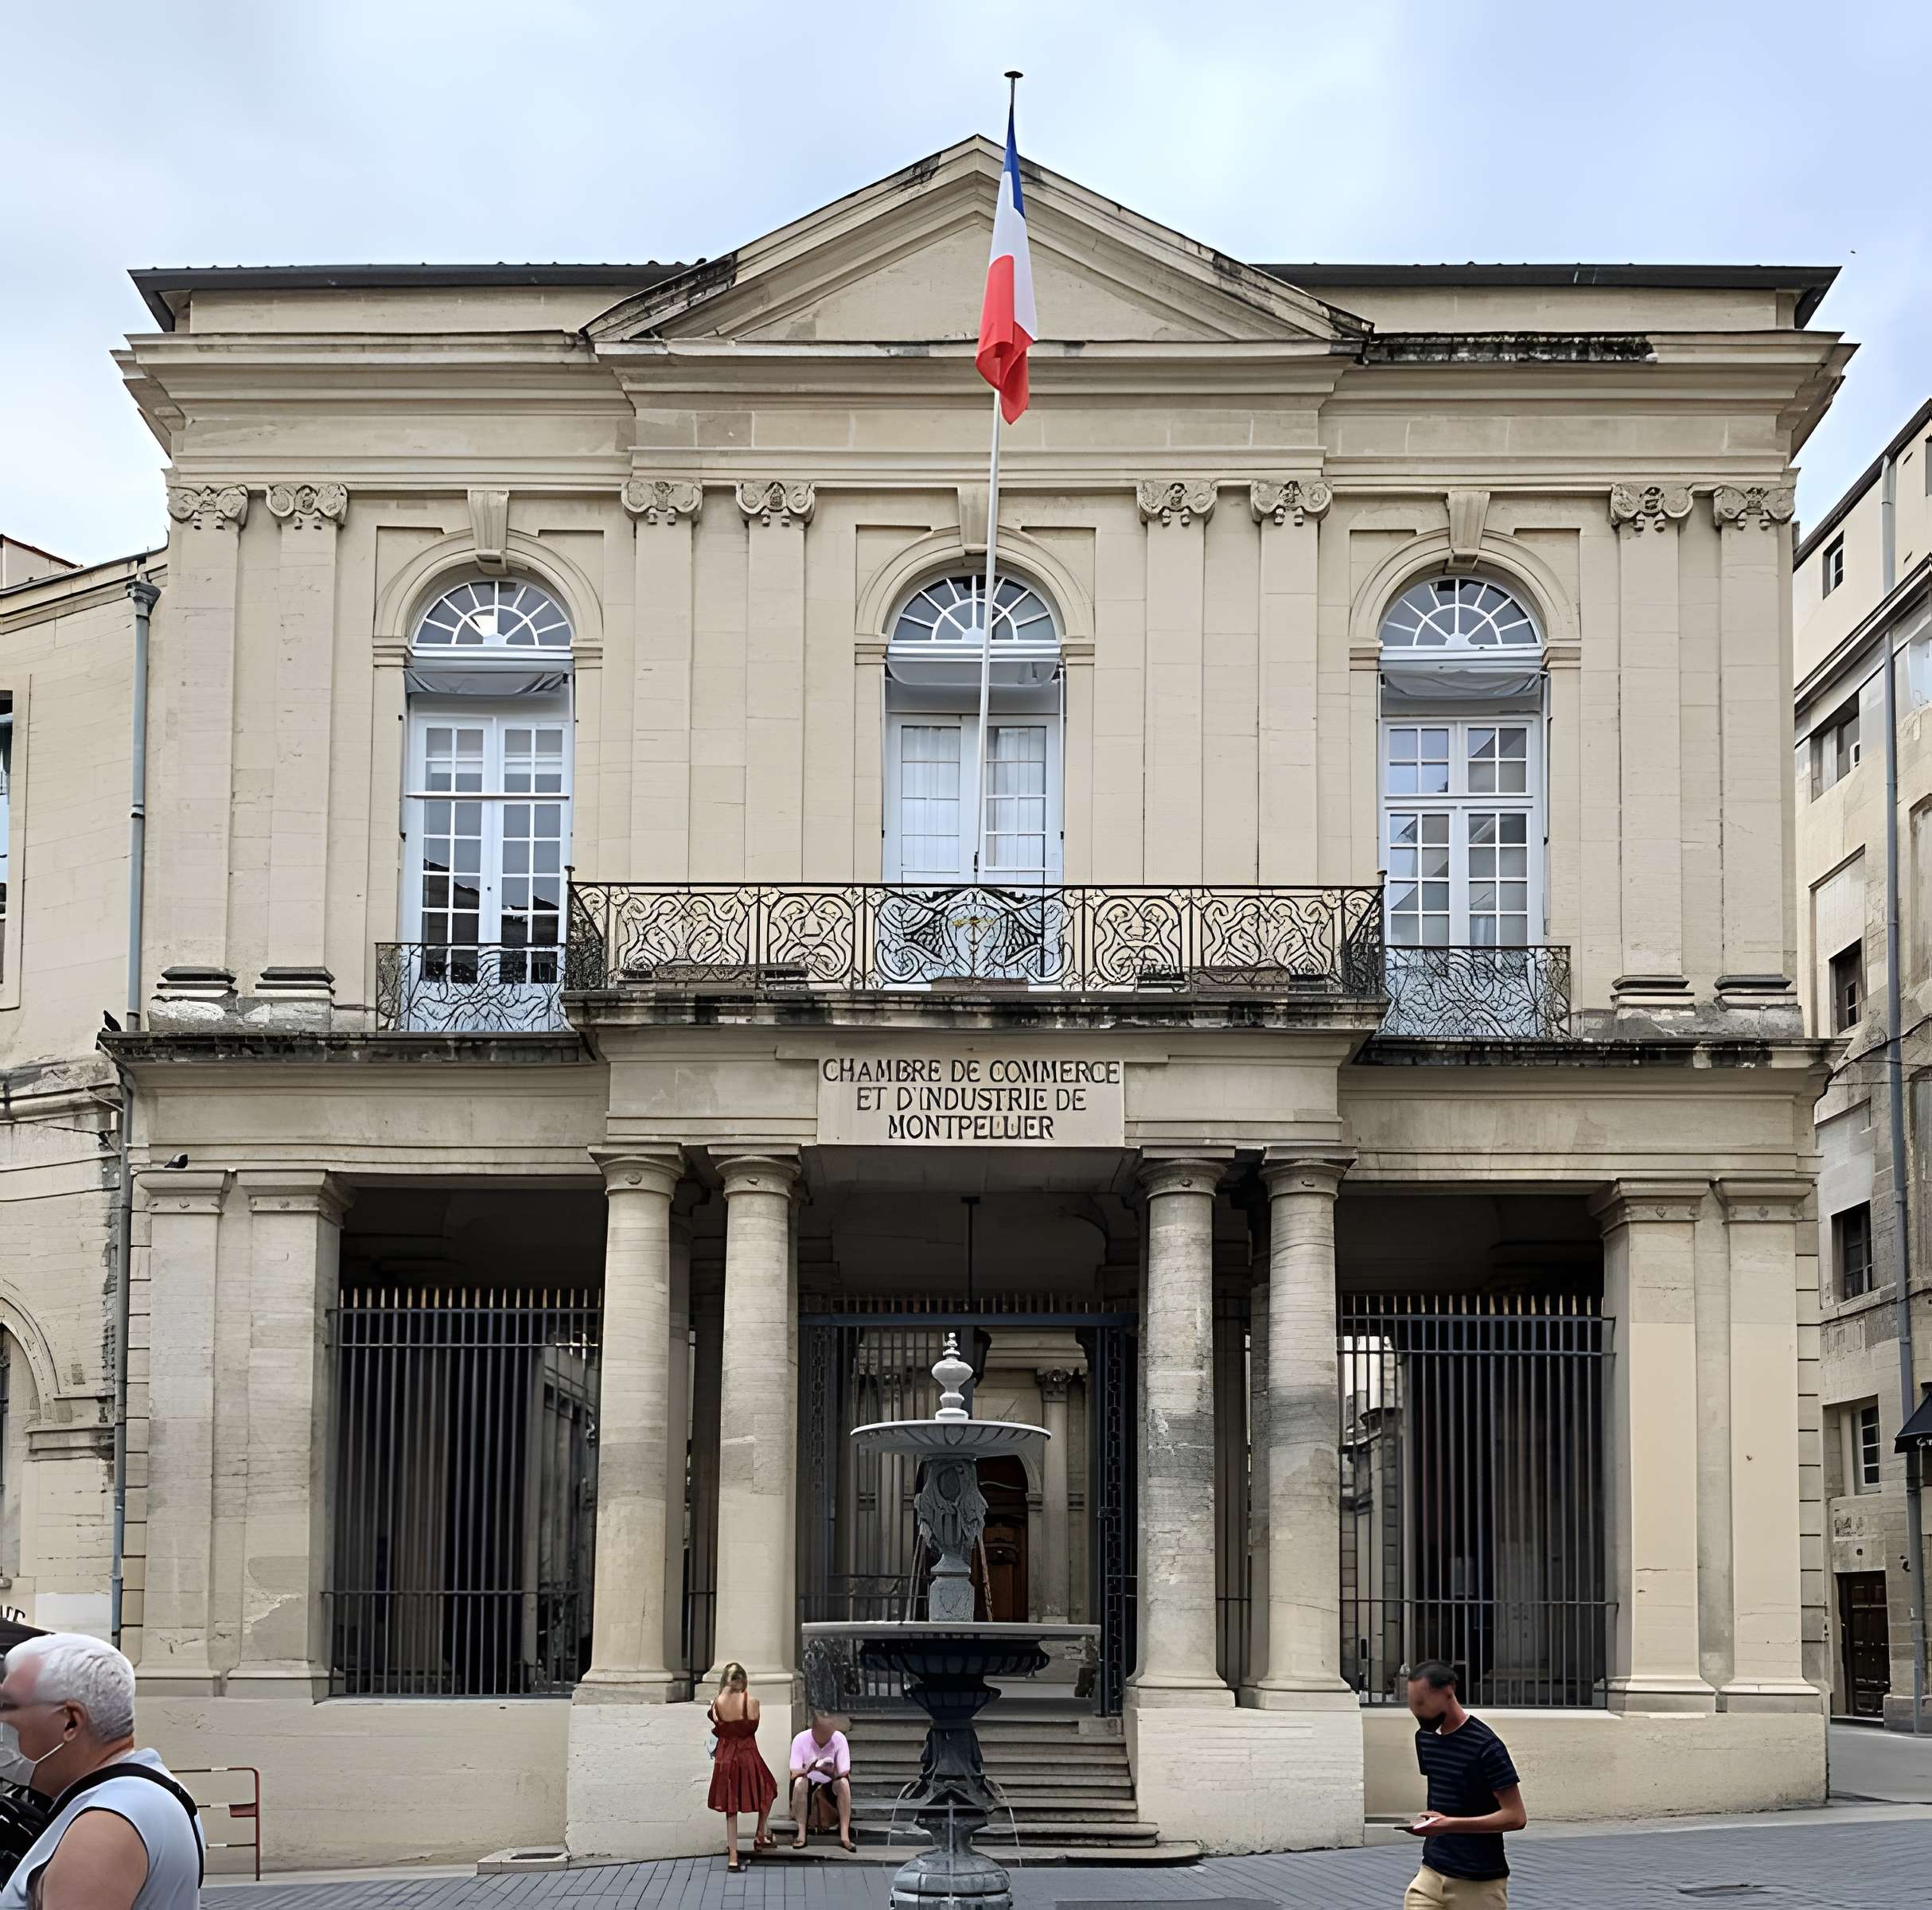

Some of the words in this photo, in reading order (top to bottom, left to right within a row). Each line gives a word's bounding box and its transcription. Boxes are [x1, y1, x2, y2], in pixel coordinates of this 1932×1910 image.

[823, 1058, 941, 1082] CHAMBRE
[951, 1059, 980, 1082] DE
[989, 1060, 1120, 1084] COMMERCE
[857, 1086, 887, 1111] ET
[897, 1087, 1047, 1111] D'INDUSTRIE
[1056, 1088, 1087, 1111] DE
